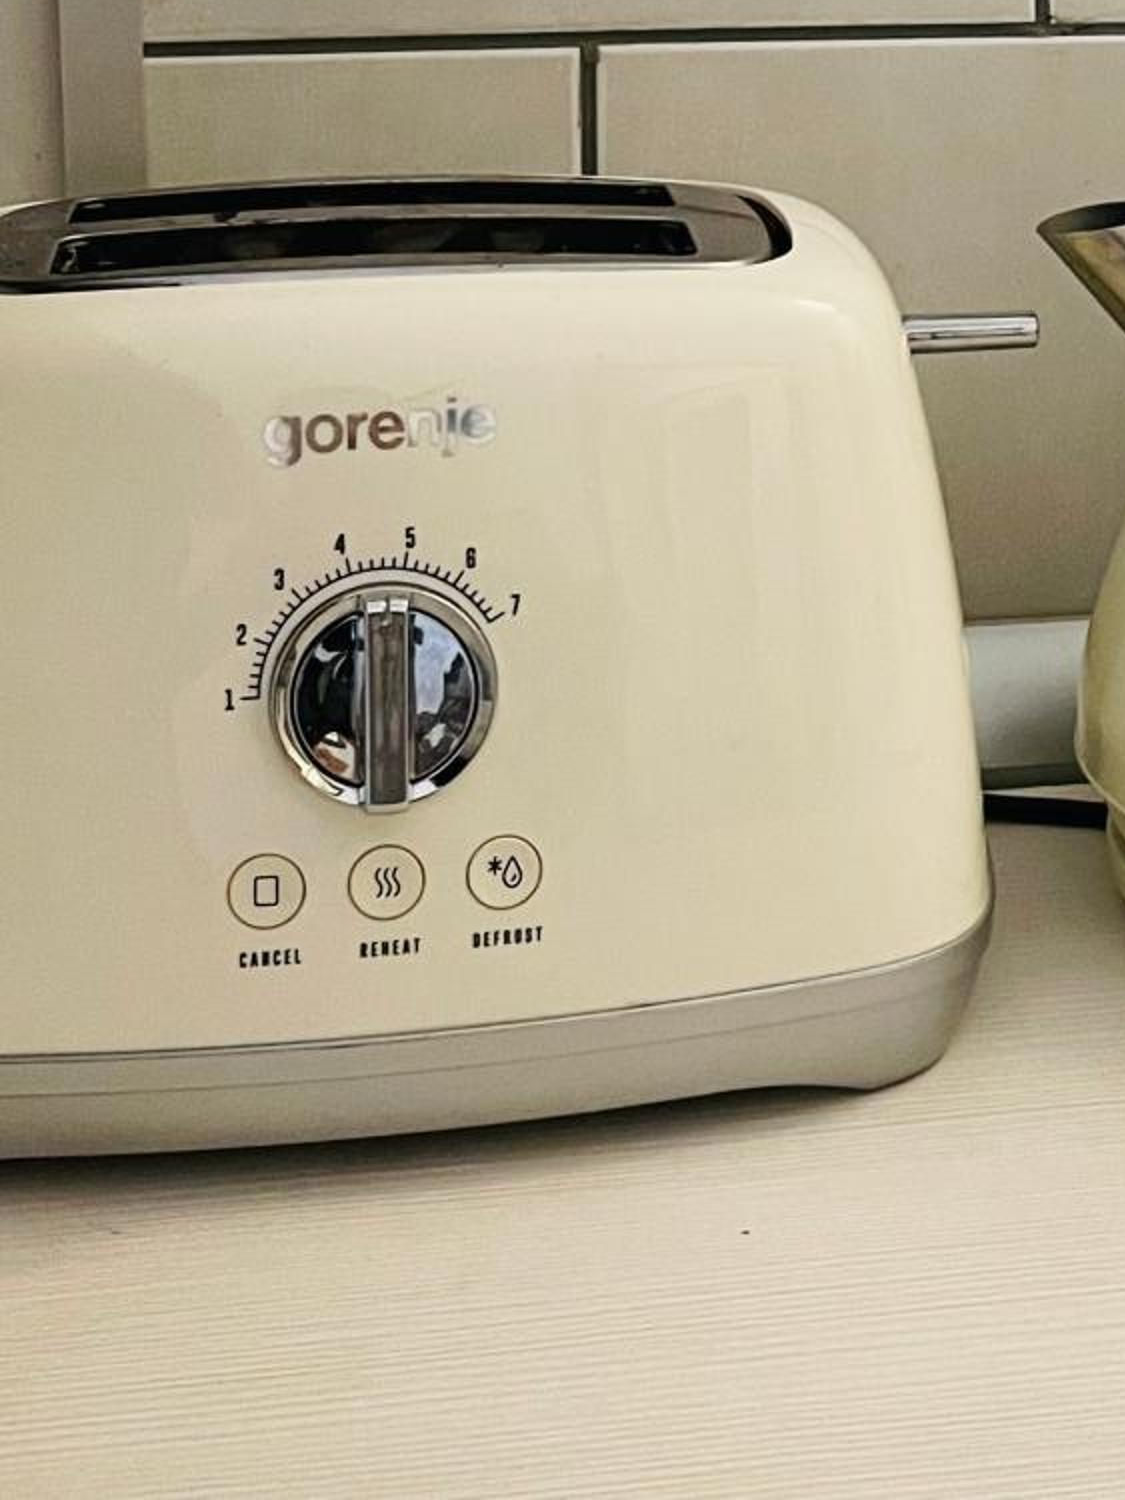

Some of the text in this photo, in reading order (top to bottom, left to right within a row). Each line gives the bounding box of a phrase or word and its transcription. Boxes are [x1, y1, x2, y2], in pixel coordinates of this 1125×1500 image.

[263, 396, 497, 468] gorenje
[224, 525, 522, 711] 1 2 3 4 5 6 7
[359, 937, 422, 959] REHEAT
[472, 926, 544, 948] DEFROST
[239, 948, 302, 968] CANCEL
